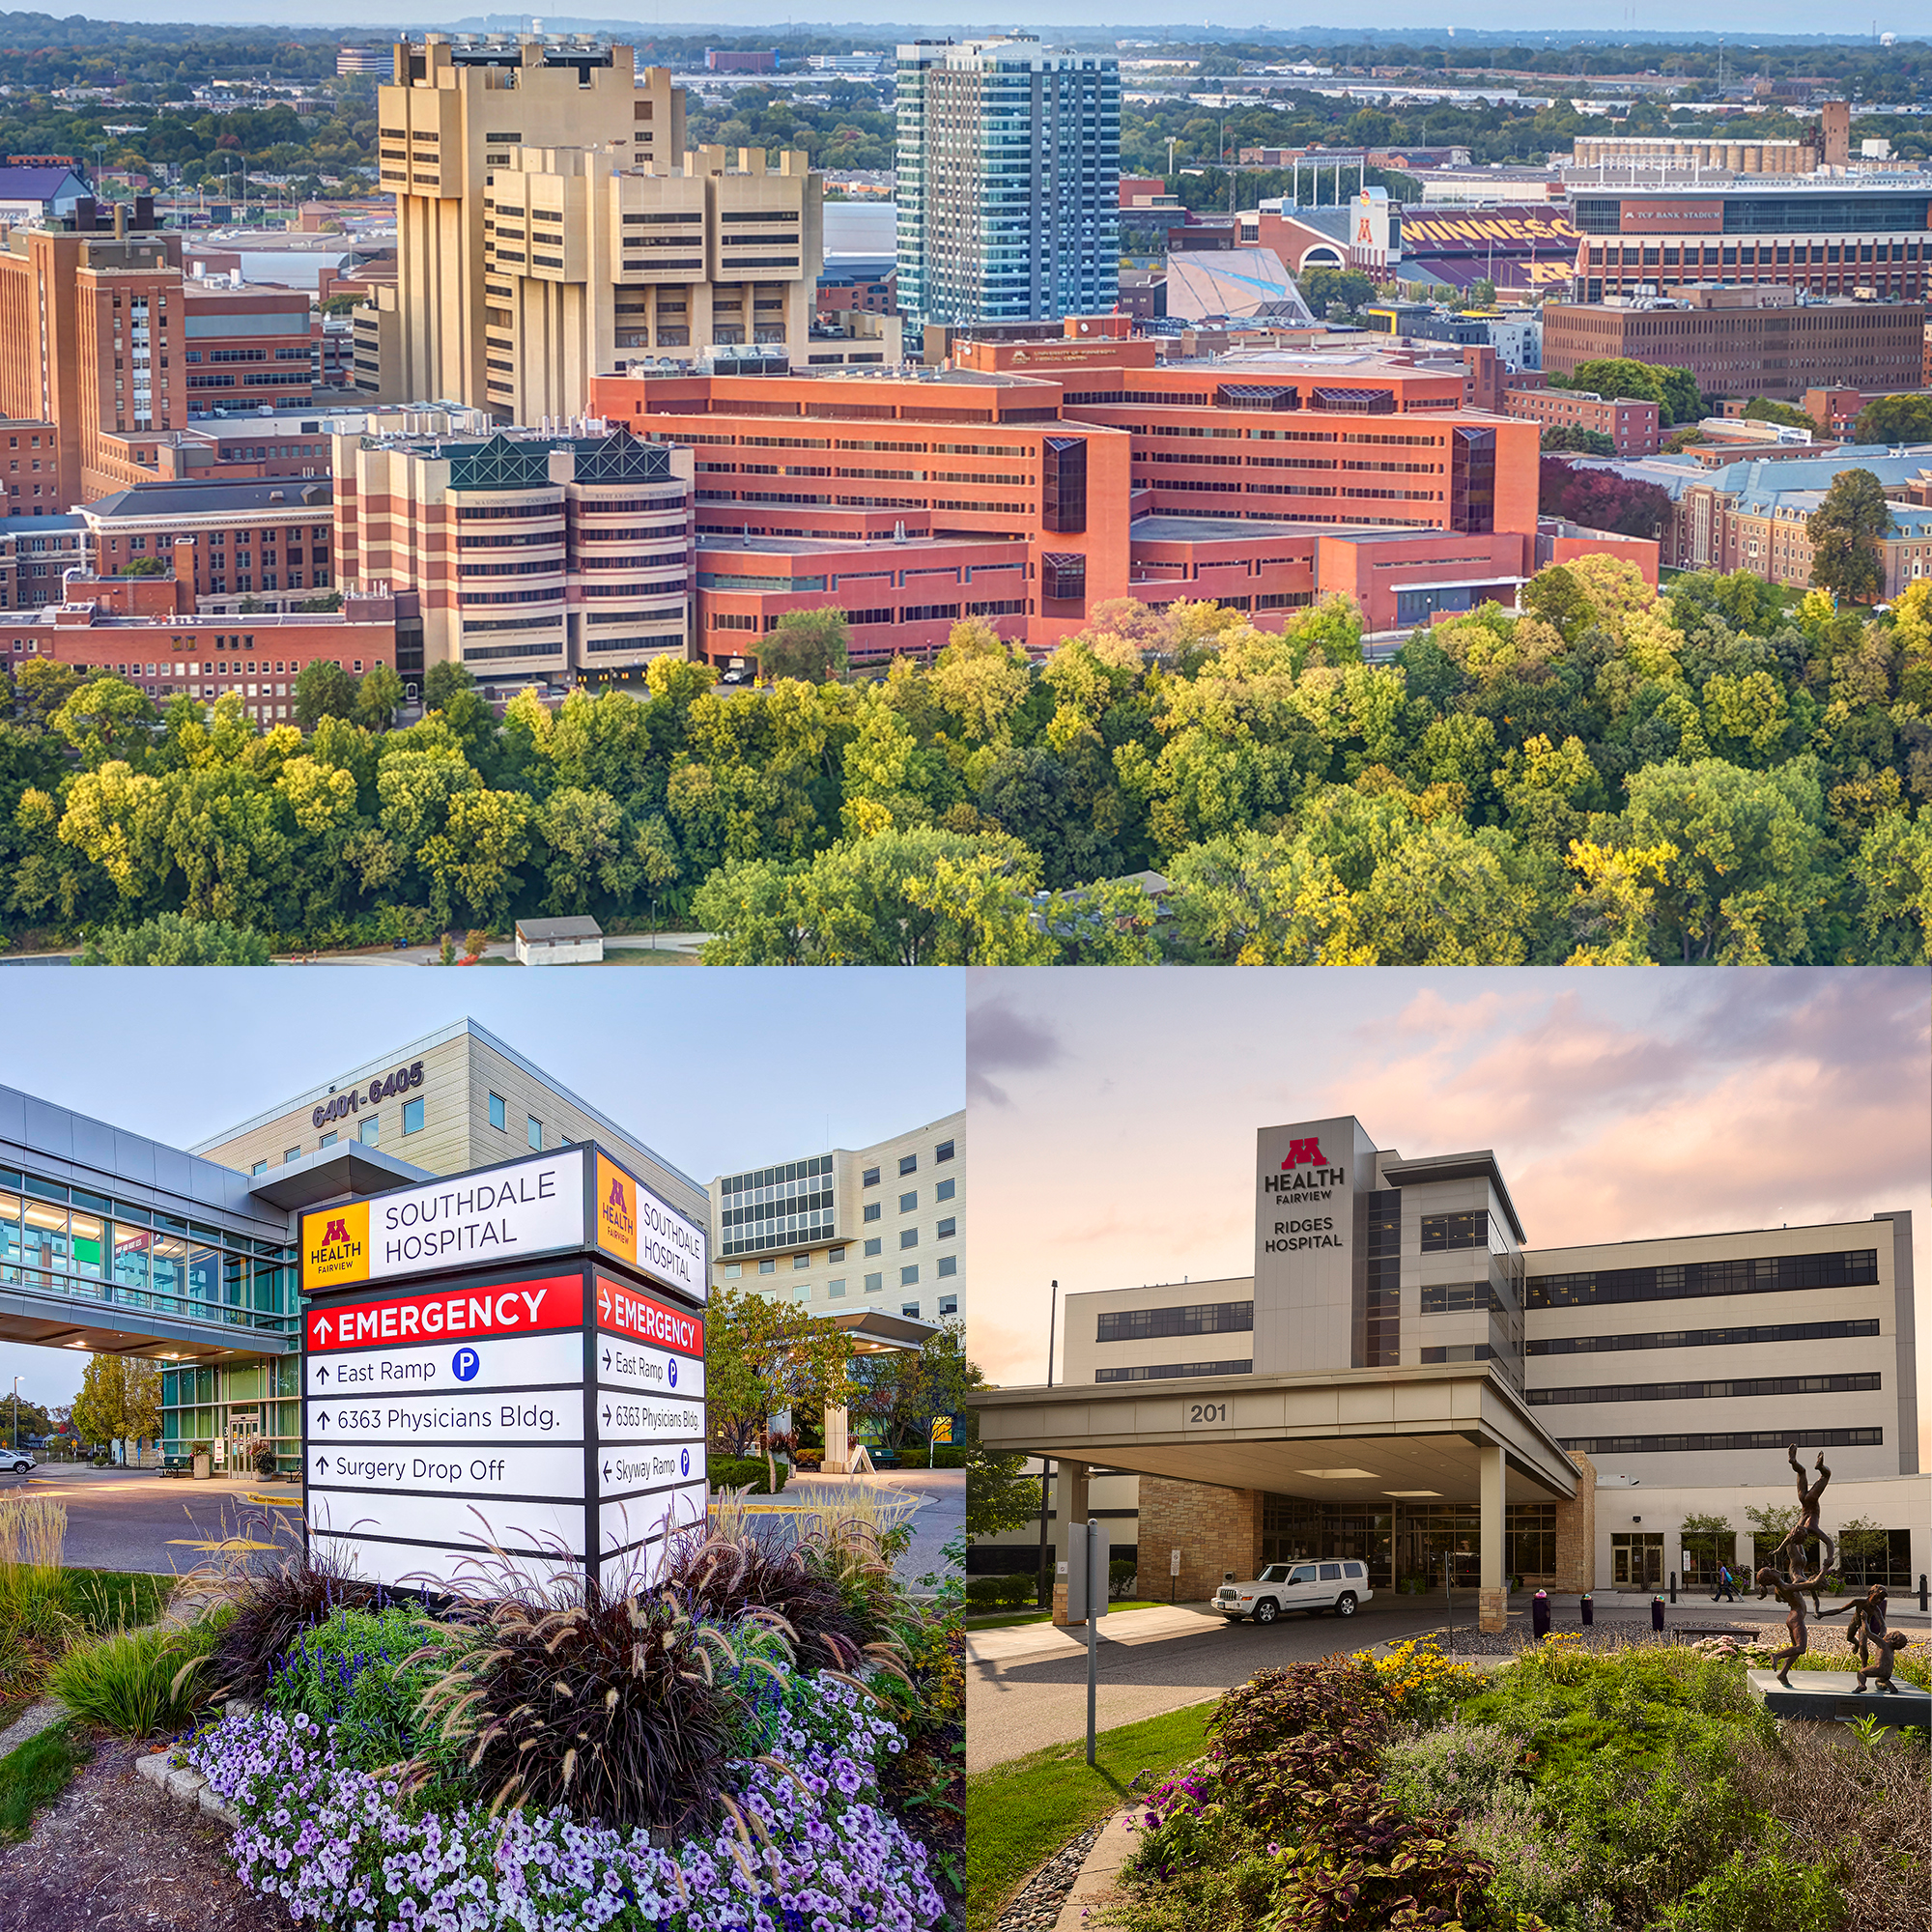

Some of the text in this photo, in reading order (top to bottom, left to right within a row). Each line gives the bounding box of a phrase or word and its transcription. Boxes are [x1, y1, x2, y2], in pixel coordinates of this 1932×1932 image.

[1265, 1167, 1344, 1193] HEALTH
[385, 1171, 555, 1230] SOUTHDALE
[1276, 1190, 1331, 1205] FAIRVIEW
[603, 1203, 633, 1236] HEALTH
[644, 1203, 699, 1260] SOUTHDALE
[1275, 1217, 1333, 1235] RIDGES
[386, 1218, 518, 1264] HOSPITAL
[608, 1226, 629, 1244] FAIRVIEW
[1265, 1235, 1343, 1253] HOSPITAL
[311, 1241, 361, 1264] HEALTH
[645, 1236, 691, 1282] HOSPITAL
[318, 1261, 354, 1274] FAIRVIEW
[339, 1289, 548, 1342] EMERGENCY
[614, 1293, 695, 1349] EMERGENCY
[338, 1363, 374, 1382] East
[381, 1361, 436, 1380] Ramp
[616, 1351, 637, 1376] East
[639, 1357, 663, 1383] Ramp
[338, 1405, 560, 1432] 6363 Physicians Bldg.
[616, 1406, 699, 1431] 6363 Physicians Bldg.
[1191, 1404, 1225, 1423] 201
[336, 1457, 505, 1483] Surgery Drop Off
[616, 1459, 650, 1483] Skyway
[653, 1457, 675, 1476] Ramp
